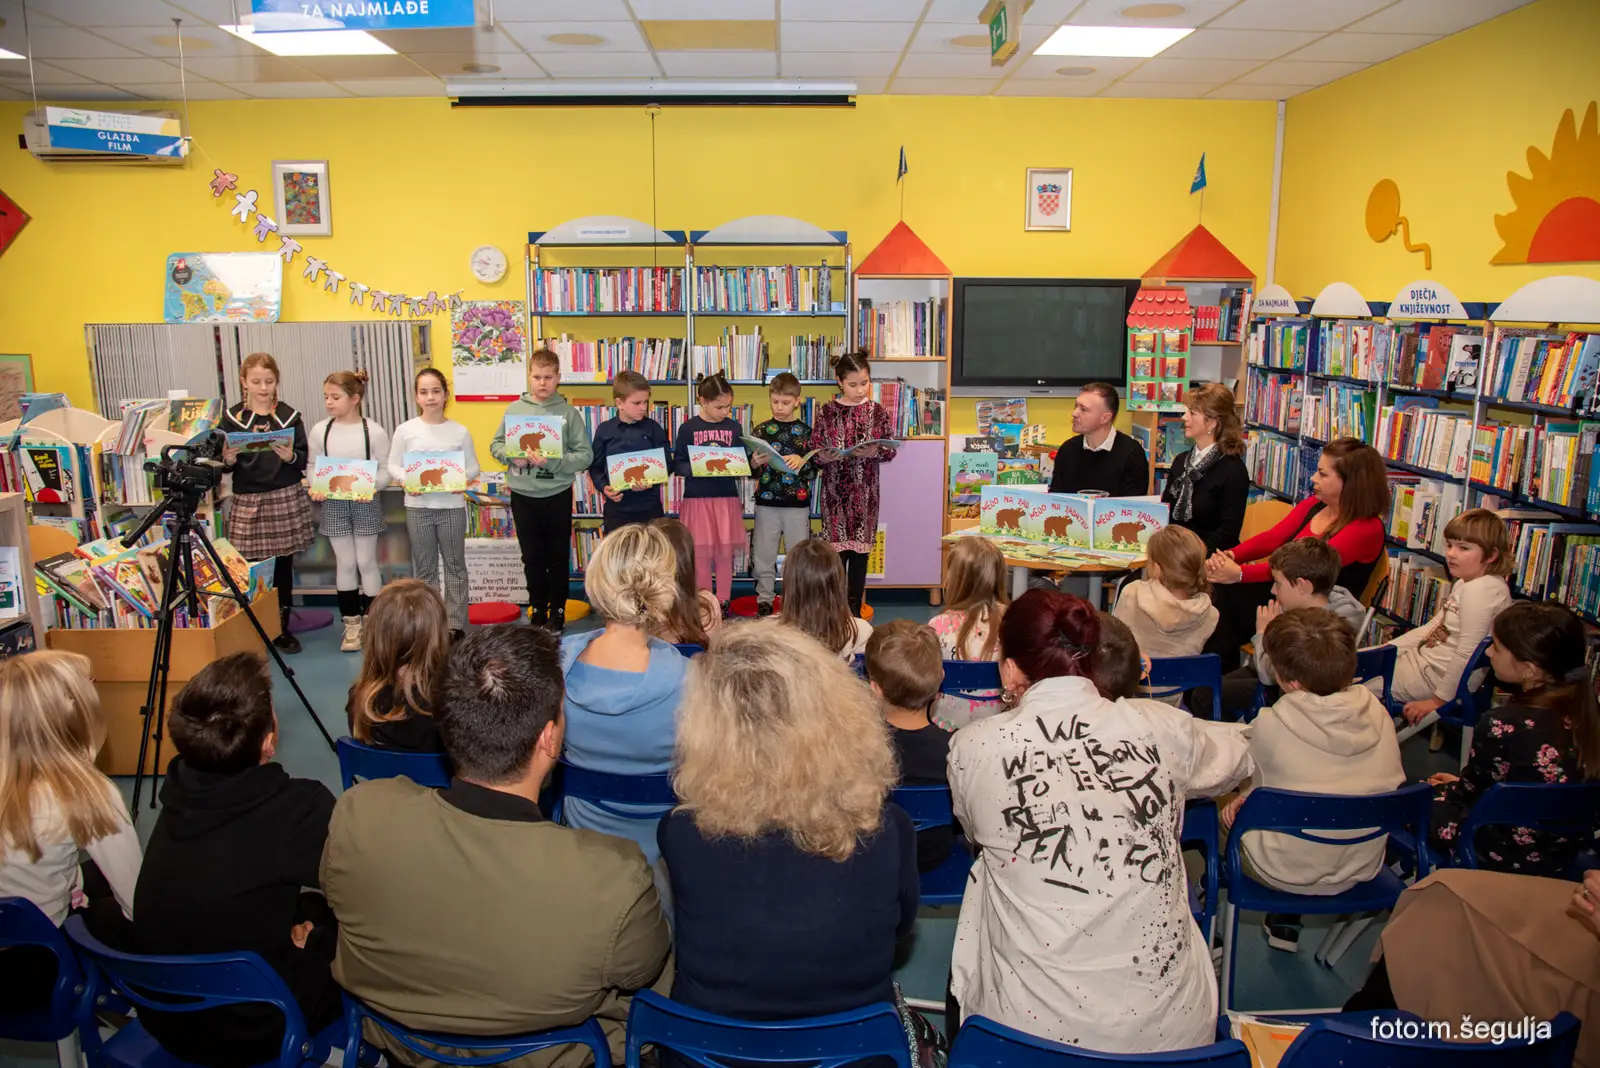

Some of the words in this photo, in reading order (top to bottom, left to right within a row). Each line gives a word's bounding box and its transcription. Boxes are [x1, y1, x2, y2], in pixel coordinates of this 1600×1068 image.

[301, 4, 324, 17] ZA
[331, 0, 429, 17] NAJMLAĐE
[97, 131, 140, 142] GLAZBA
[107, 141, 132, 151] FILM
[1410, 288, 1437, 300] DJEČJA
[1400, 304, 1450, 315] KNJIŽEVNOST
[694, 430, 732, 446] HOGWARTS
[982, 497, 999, 512] MEDO
[1003, 495, 1014, 504] NA
[1029, 503, 1048, 521] MEDO
[1051, 503, 1061, 511] NA
[1096, 511, 1116, 527] MEDO
[1121, 508, 1133, 517] NA
[1036, 714, 1091, 743] WE
[1009, 774, 1049, 806] TO
